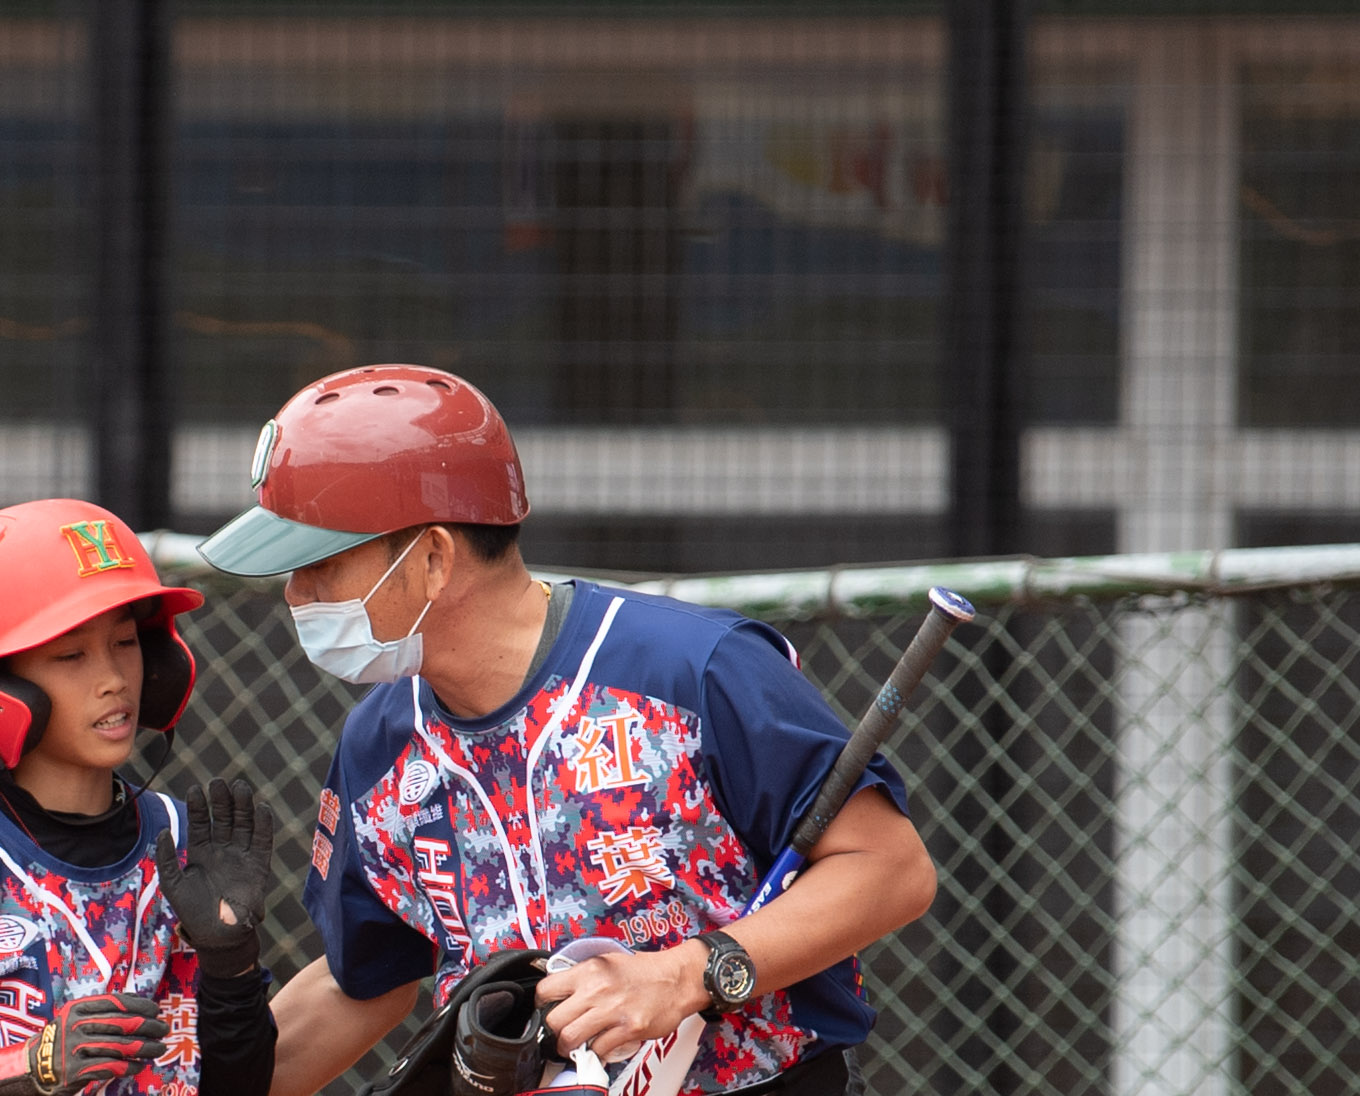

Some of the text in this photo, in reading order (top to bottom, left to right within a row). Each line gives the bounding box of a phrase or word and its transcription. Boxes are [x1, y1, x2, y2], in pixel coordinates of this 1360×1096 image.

[747, 882, 772, 915] EAS
[618, 900, 688, 946] 1968
[40, 1023, 57, 1084] ZETT
